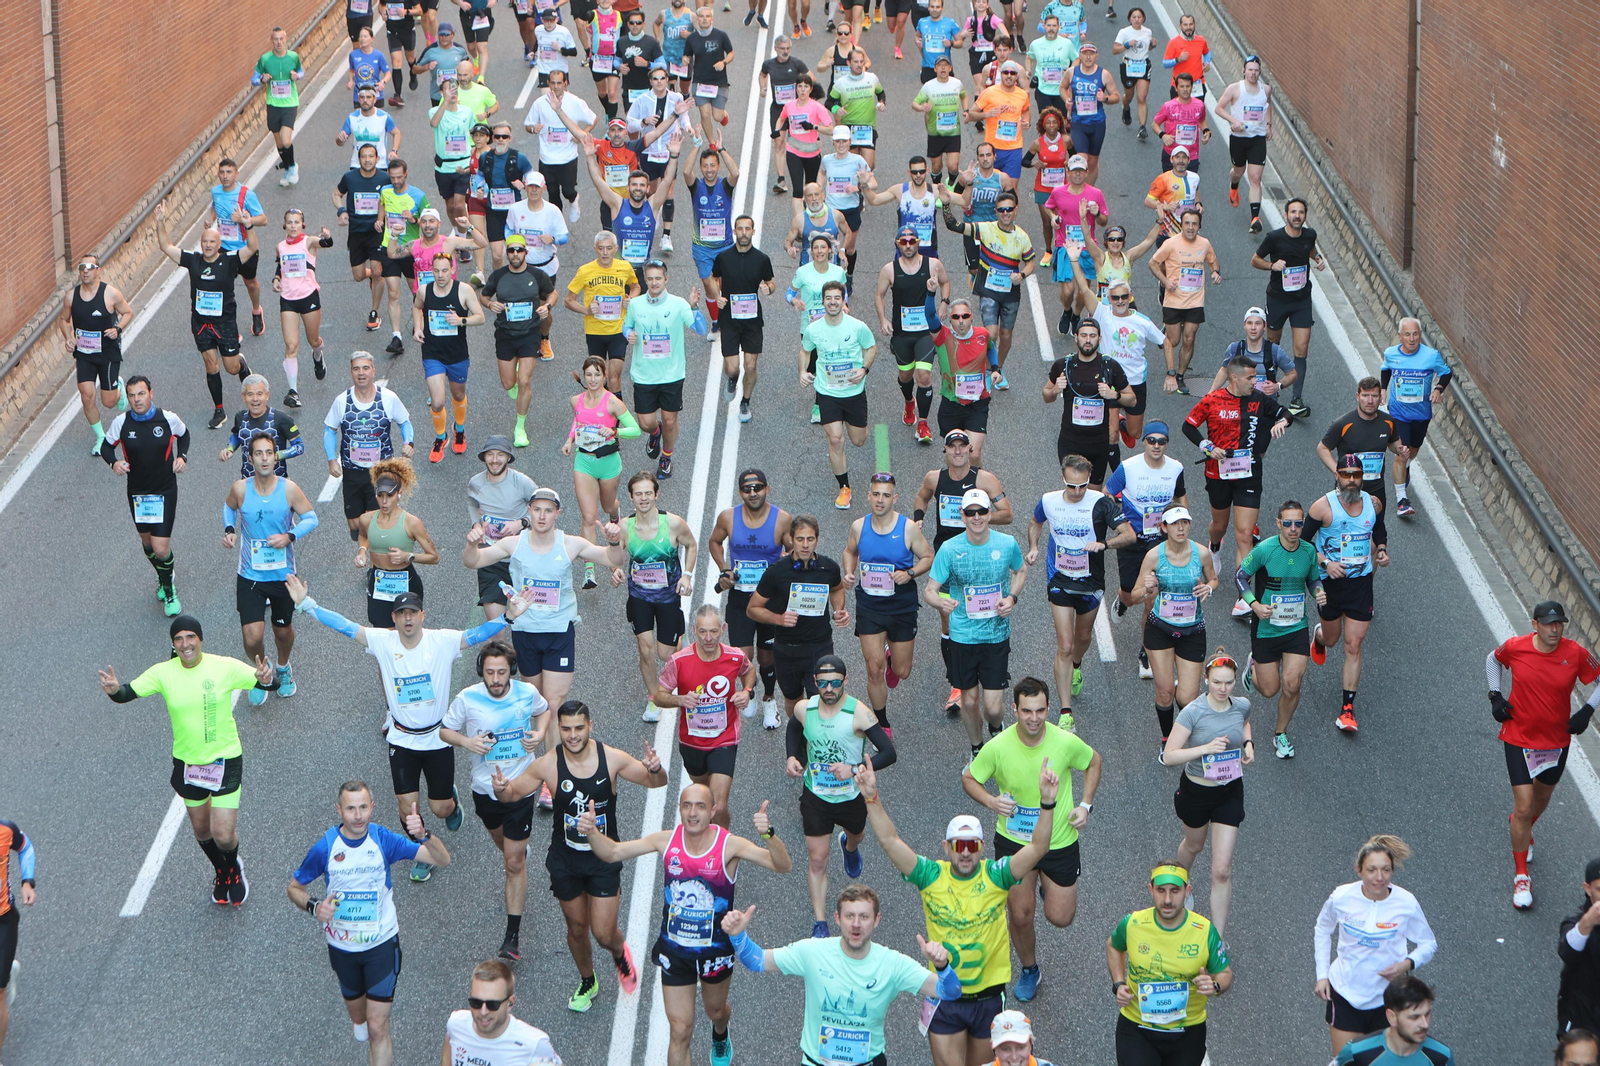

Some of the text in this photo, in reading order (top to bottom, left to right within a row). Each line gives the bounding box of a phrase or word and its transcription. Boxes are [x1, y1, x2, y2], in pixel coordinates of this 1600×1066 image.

[1076, 82, 1097, 91] CTC
[588, 276, 623, 288] MICHIGAN
[1219, 410, 1239, 419] 42,195
[698, 696, 728, 704] ALLENGE
[822, 1015, 865, 1026] SEVILLA'24
[837, 1032, 864, 1040] ZURICH
[467, 1056, 491, 1066] MEDIA
